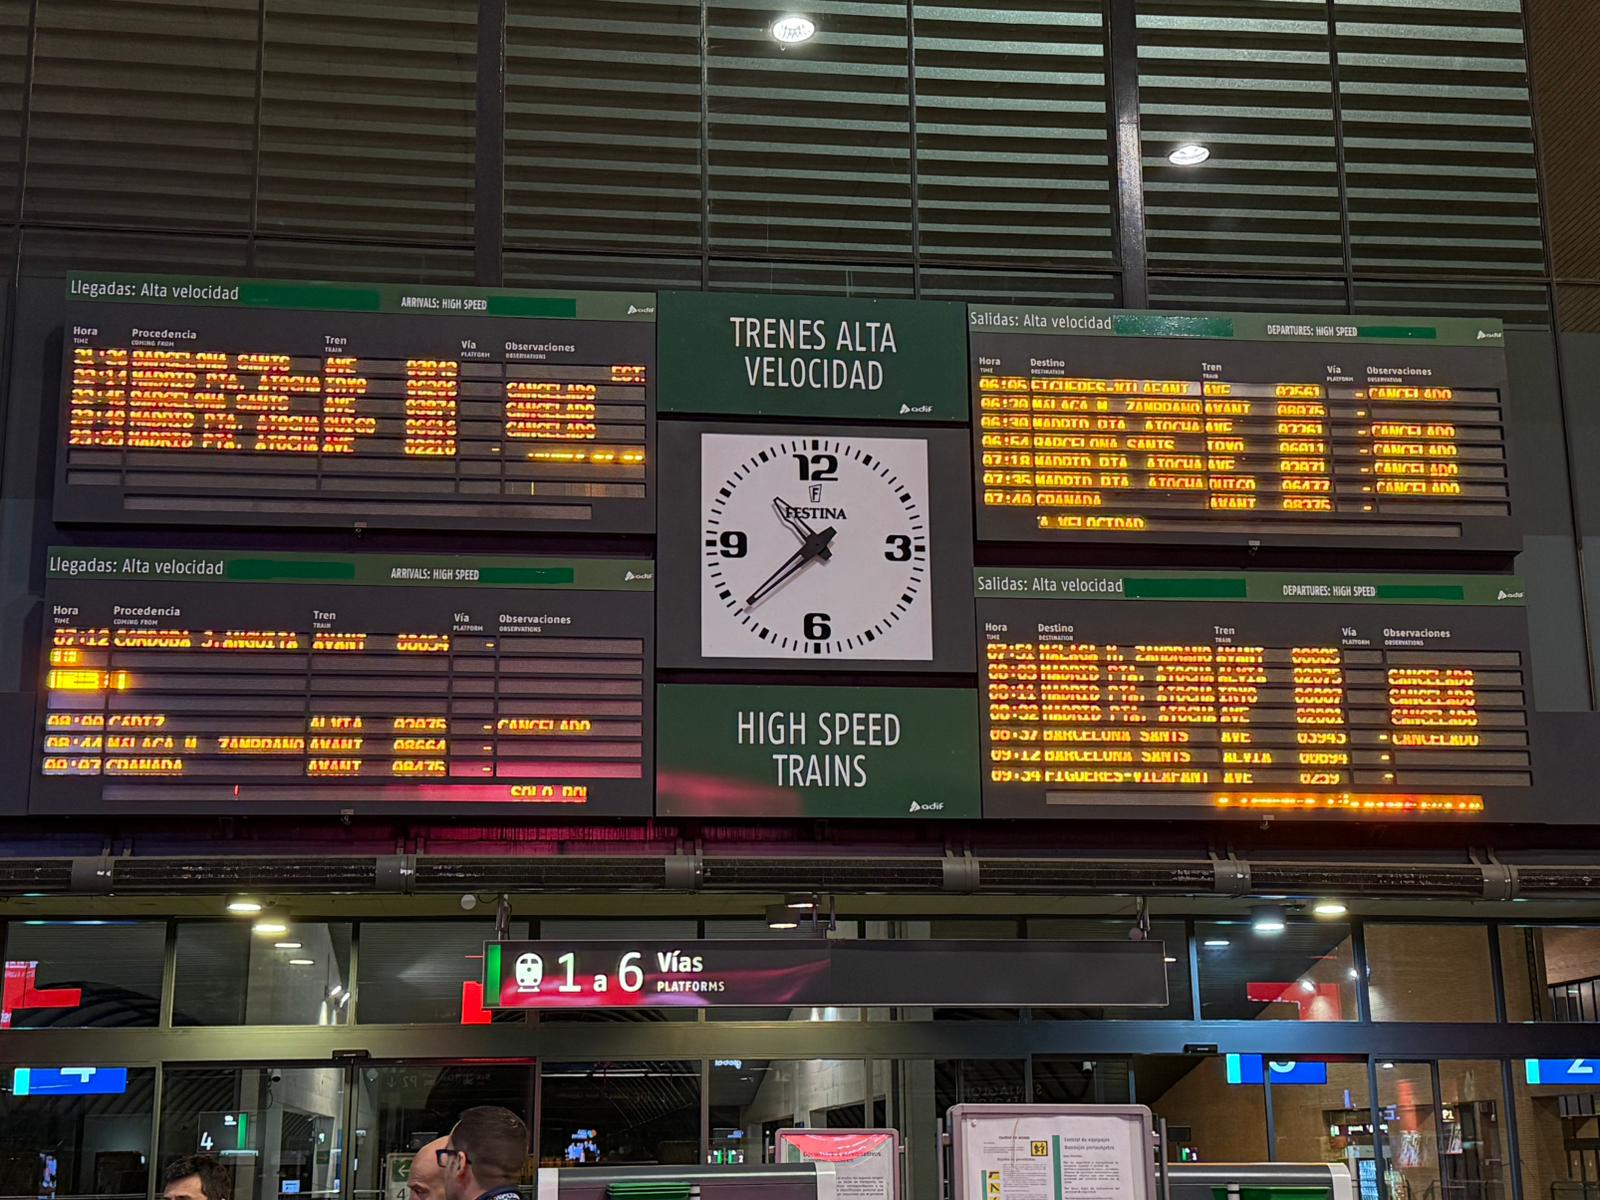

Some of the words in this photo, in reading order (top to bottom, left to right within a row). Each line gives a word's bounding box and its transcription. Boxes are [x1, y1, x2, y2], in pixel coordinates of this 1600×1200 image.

[71, 280, 136, 297] Llegadas:
[141, 282, 167, 298] Alta
[172, 283, 239, 300] velocidad
[401, 297, 440, 309] ARRIVALS:
[442, 298, 460, 309] HIGH
[463, 299, 487, 310] SPEED
[970, 312, 1019, 326] Salidas:
[1023, 314, 1047, 327] Alta
[1052, 315, 1112, 329] velocidad
[73, 326, 98, 336] Hora
[132, 329, 197, 340] Procedencia
[730, 317, 826, 350] TRENES
[836, 321, 897, 352] ALTA
[1267, 325, 1314, 336] DEPARTURES:
[1316, 326, 1334, 336] HIGH
[1336, 327, 1358, 337] SPEED
[325, 335, 347, 345] Tren
[461, 340, 476, 350] Vía
[505, 342, 575, 353] Observaciones
[979, 357, 1001, 365] Hora
[1030, 358, 1065, 367] Destino
[1202, 363, 1222, 371] Tren
[1327, 365, 1341, 374] Vía
[1367, 366, 1432, 376] Observaciones
[744, 356, 884, 390] VELOCIDAD
[911, 405, 933, 413] adif
[792, 454, 839, 481] 12
[785, 507, 847, 520] FESTINA
[720, 531, 748, 558] 9
[885, 535, 912, 562] 3
[50, 557, 117, 575] Llegadas:
[122, 559, 150, 573] Alta
[155, 560, 224, 575] velocidad
[391, 568, 430, 580] ARRIVALS:
[433, 569, 452, 580] HIGH
[455, 570, 479, 581] SPEED
[978, 577, 1028, 591] Salidas:
[1032, 578, 1056, 591] Alta
[1061, 579, 1123, 592] velocidad
[1282, 585, 1331, 597] DEPARTURES:
[1333, 586, 1351, 597] HIGH
[1353, 586, 1376, 597] SPEED
[53, 605, 78, 615] Hora
[114, 606, 181, 616] Procedencia
[313, 611, 336, 620] Tren
[454, 613, 470, 622] Vía
[499, 615, 571, 625] Observaciones
[804, 612, 831, 640] 6
[985, 623, 1007, 631] Hora
[1038, 624, 1073, 633] Destino
[1214, 626, 1234, 635] Tren
[1342, 627, 1357, 636] Vía
[1383, 628, 1450, 638] Observaciones
[738, 711, 806, 745] HIGH
[819, 712, 901, 746] SPEED
[773, 754, 867, 787] TRAINS
[921, 802, 944, 811] adif
[657, 950, 703, 973] Vías
[558, 952, 582, 992] 1
[593, 973, 607, 992] a
[618, 951, 644, 993] 6
[657, 981, 724, 992] PLATFORMS
[1442, 1109, 1454, 1119] P1
[200, 1131, 213, 1150] 4
